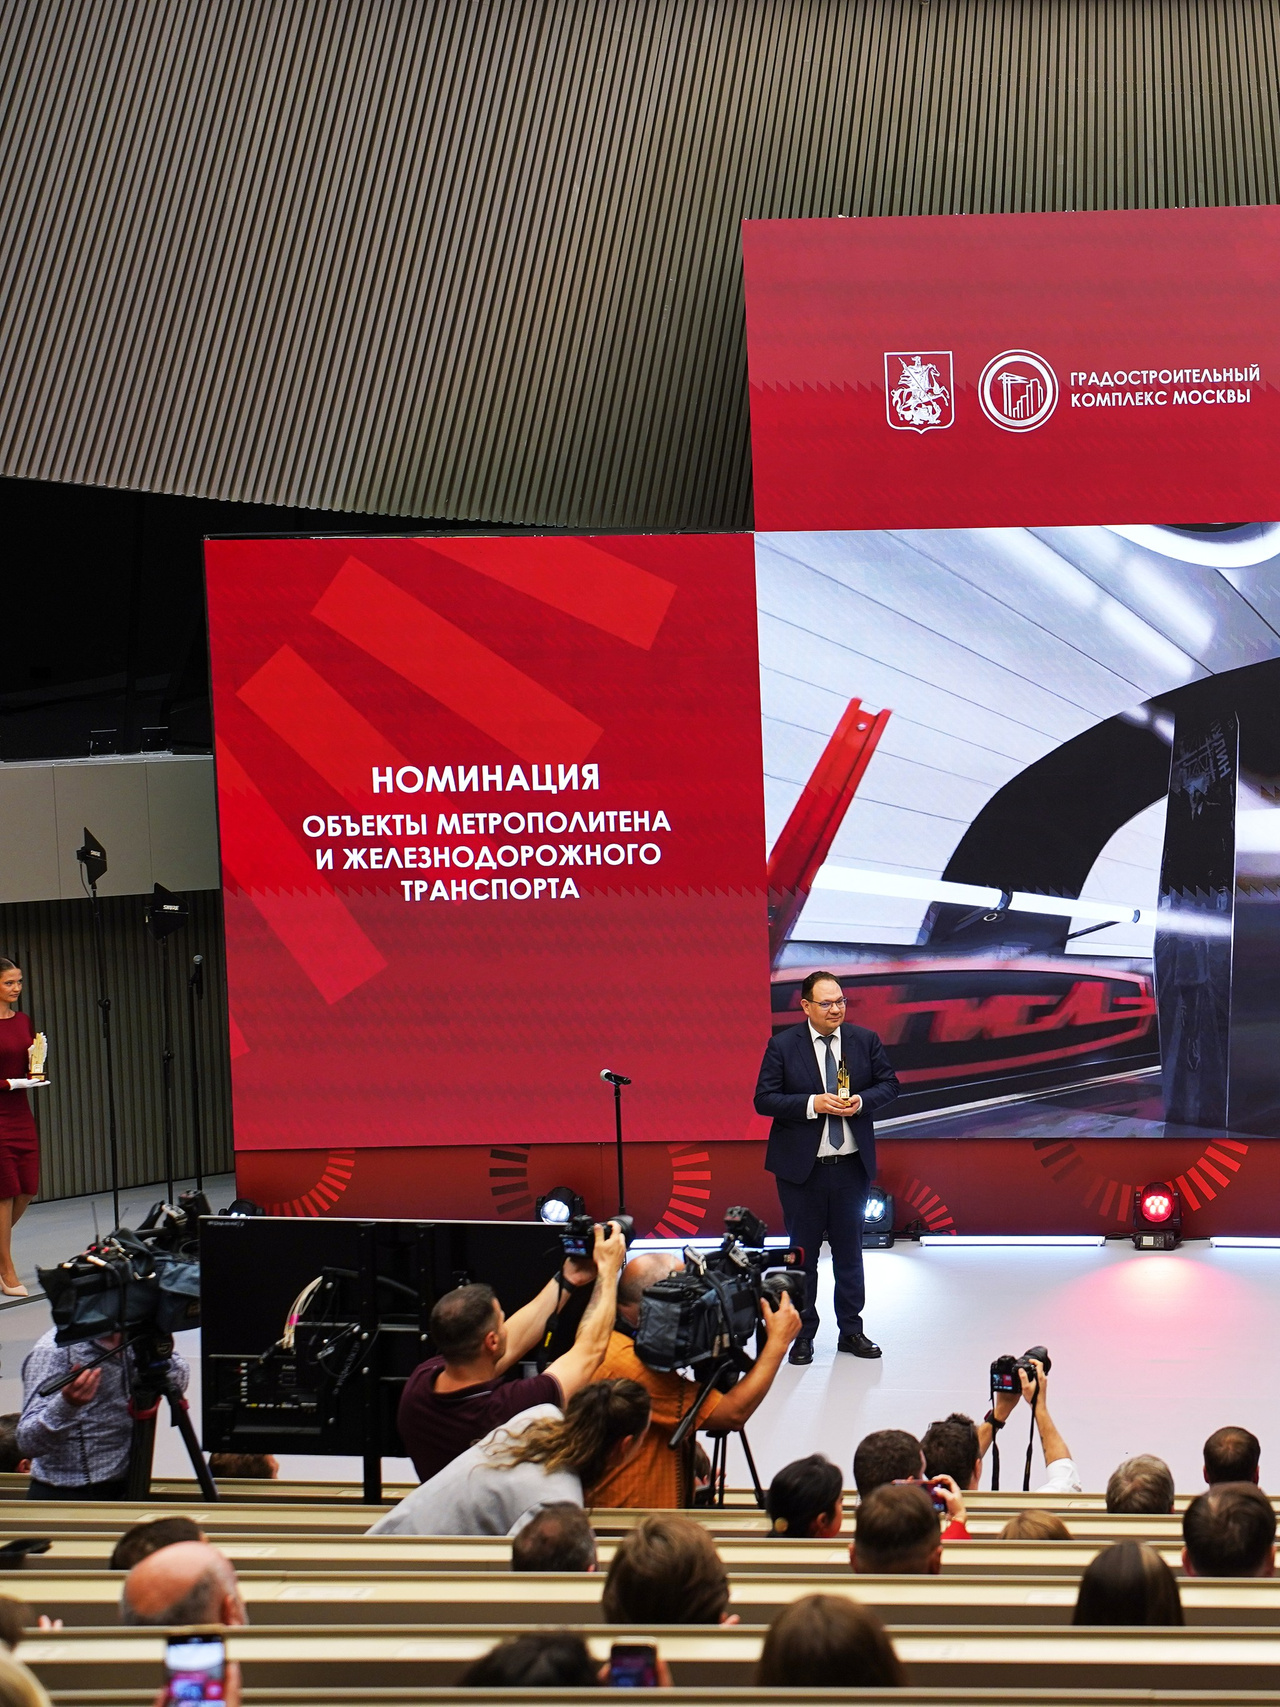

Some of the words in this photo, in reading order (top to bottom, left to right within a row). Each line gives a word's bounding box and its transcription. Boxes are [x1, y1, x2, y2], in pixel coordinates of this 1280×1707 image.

[1070, 363, 1260, 387] ГРАДОСТРОИТЕЛЬНЫЙ
[1071, 388, 1168, 408] КОМПЛЕКС
[1172, 388, 1251, 405] МОСКВЫ
[371, 763, 600, 795] НОМИНАЦИЯ
[302, 813, 427, 838] ОБЪЕКТЫ
[436, 810, 672, 836] МЕТРОПОЛИТЕНА
[315, 848, 334, 870] И
[342, 842, 662, 871] ЖЕЛЕЗНОДОРОЖНОГО
[400, 877, 581, 902] ТРАНСПОРТА
